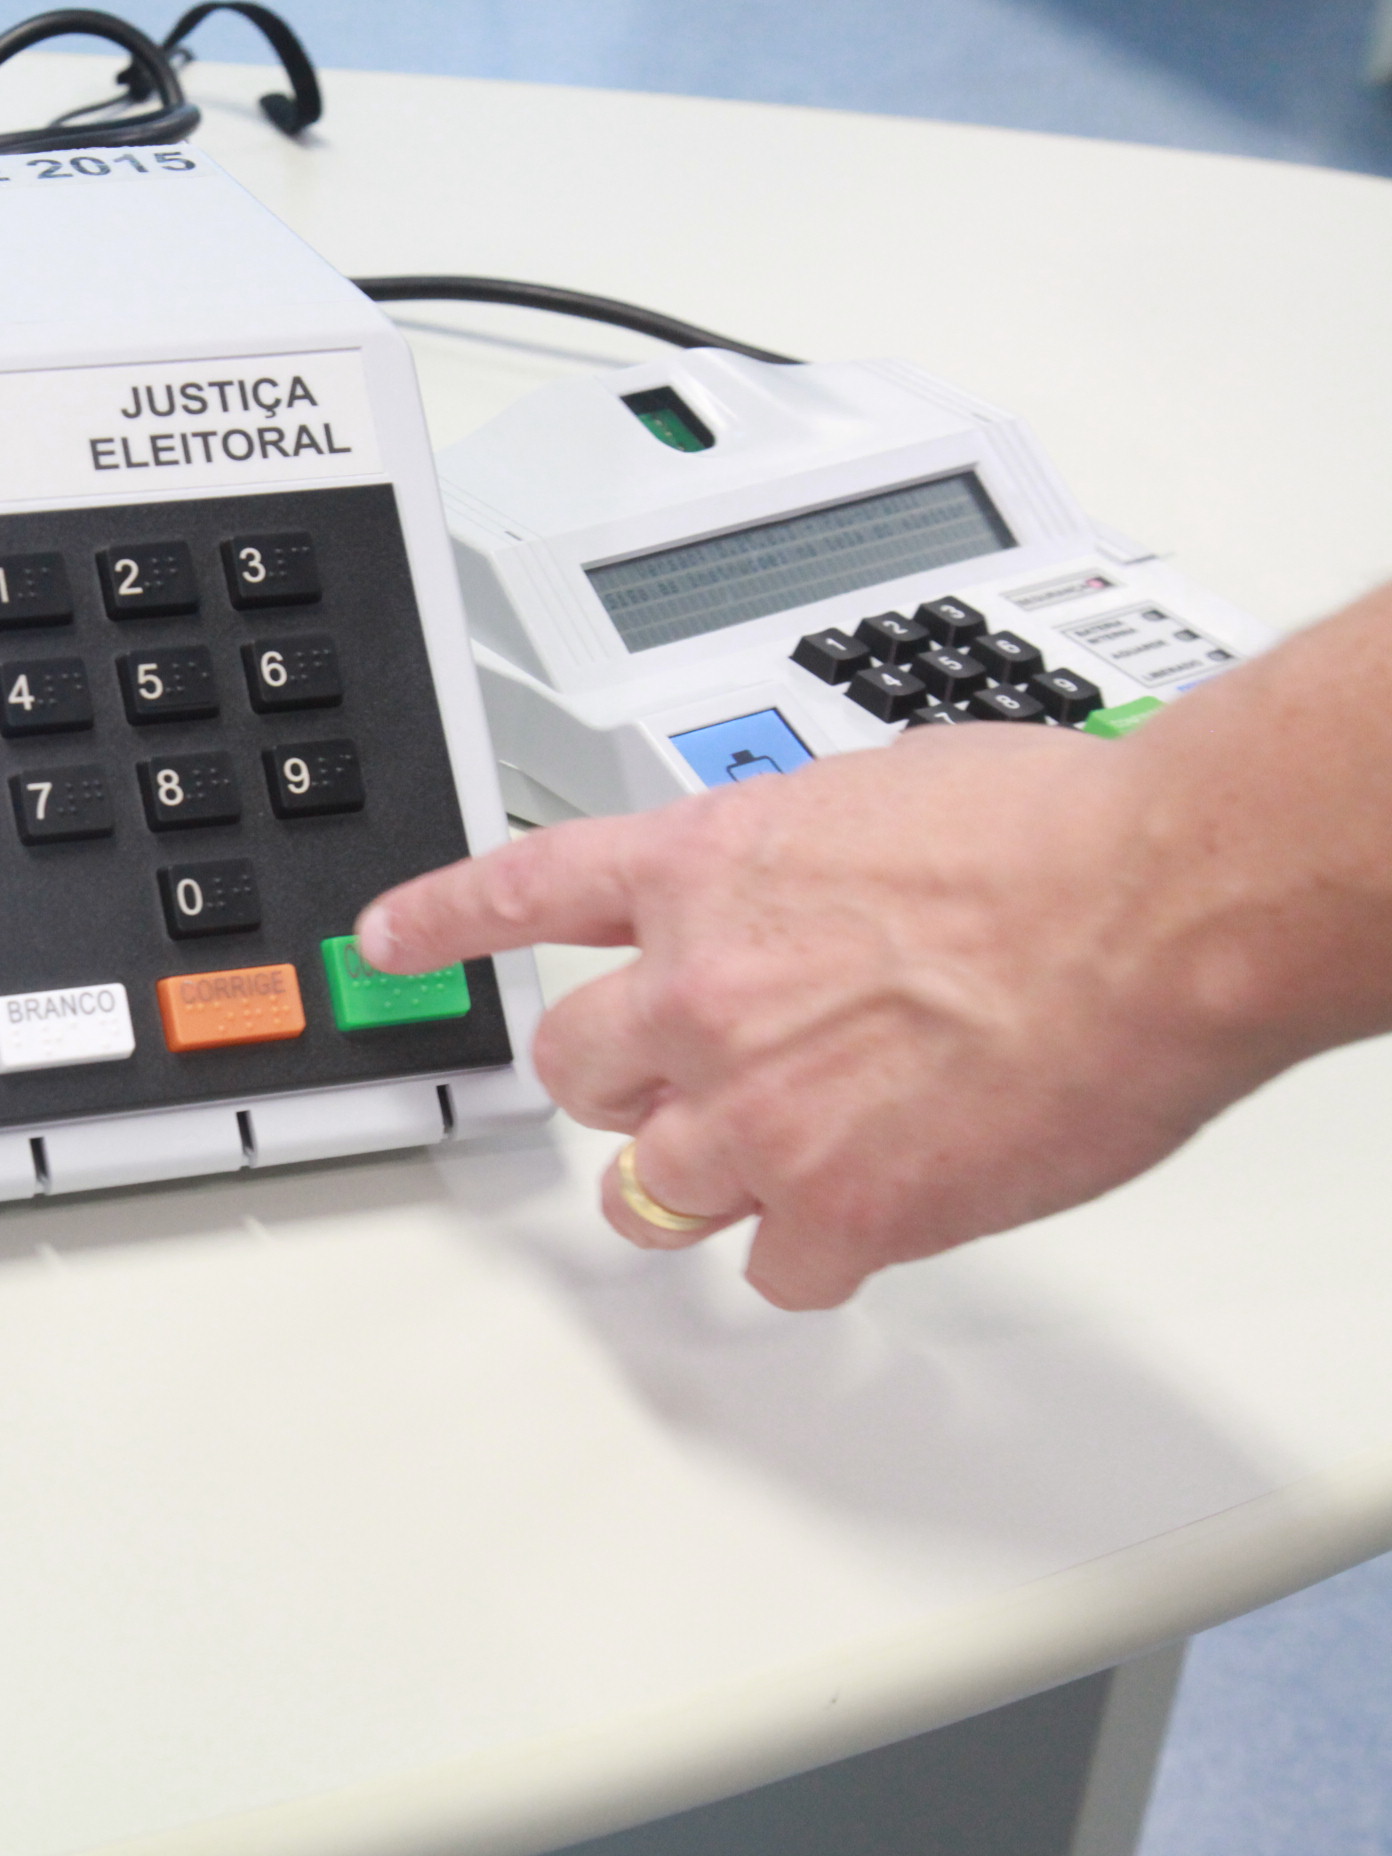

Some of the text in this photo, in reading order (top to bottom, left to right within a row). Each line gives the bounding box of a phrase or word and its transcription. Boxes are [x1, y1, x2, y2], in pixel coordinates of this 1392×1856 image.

[26, 151, 197, 179] 2015
[121, 375, 319, 418] JUSTIÇA
[89, 422, 352, 471] ELEITORAL
[114, 559, 143, 596] 2
[238, 547, 267, 584] 3
[136, 663, 164, 700] 5
[260, 651, 288, 688] 6
[8, 674, 35, 711] 4
[156, 769, 184, 806] 8
[283, 757, 311, 794] 9
[26, 782, 52, 819] 7
[176, 879, 203, 916] 0
[179, 971, 286, 1004] CORRIGE
[6, 989, 116, 1025] BRANCO
